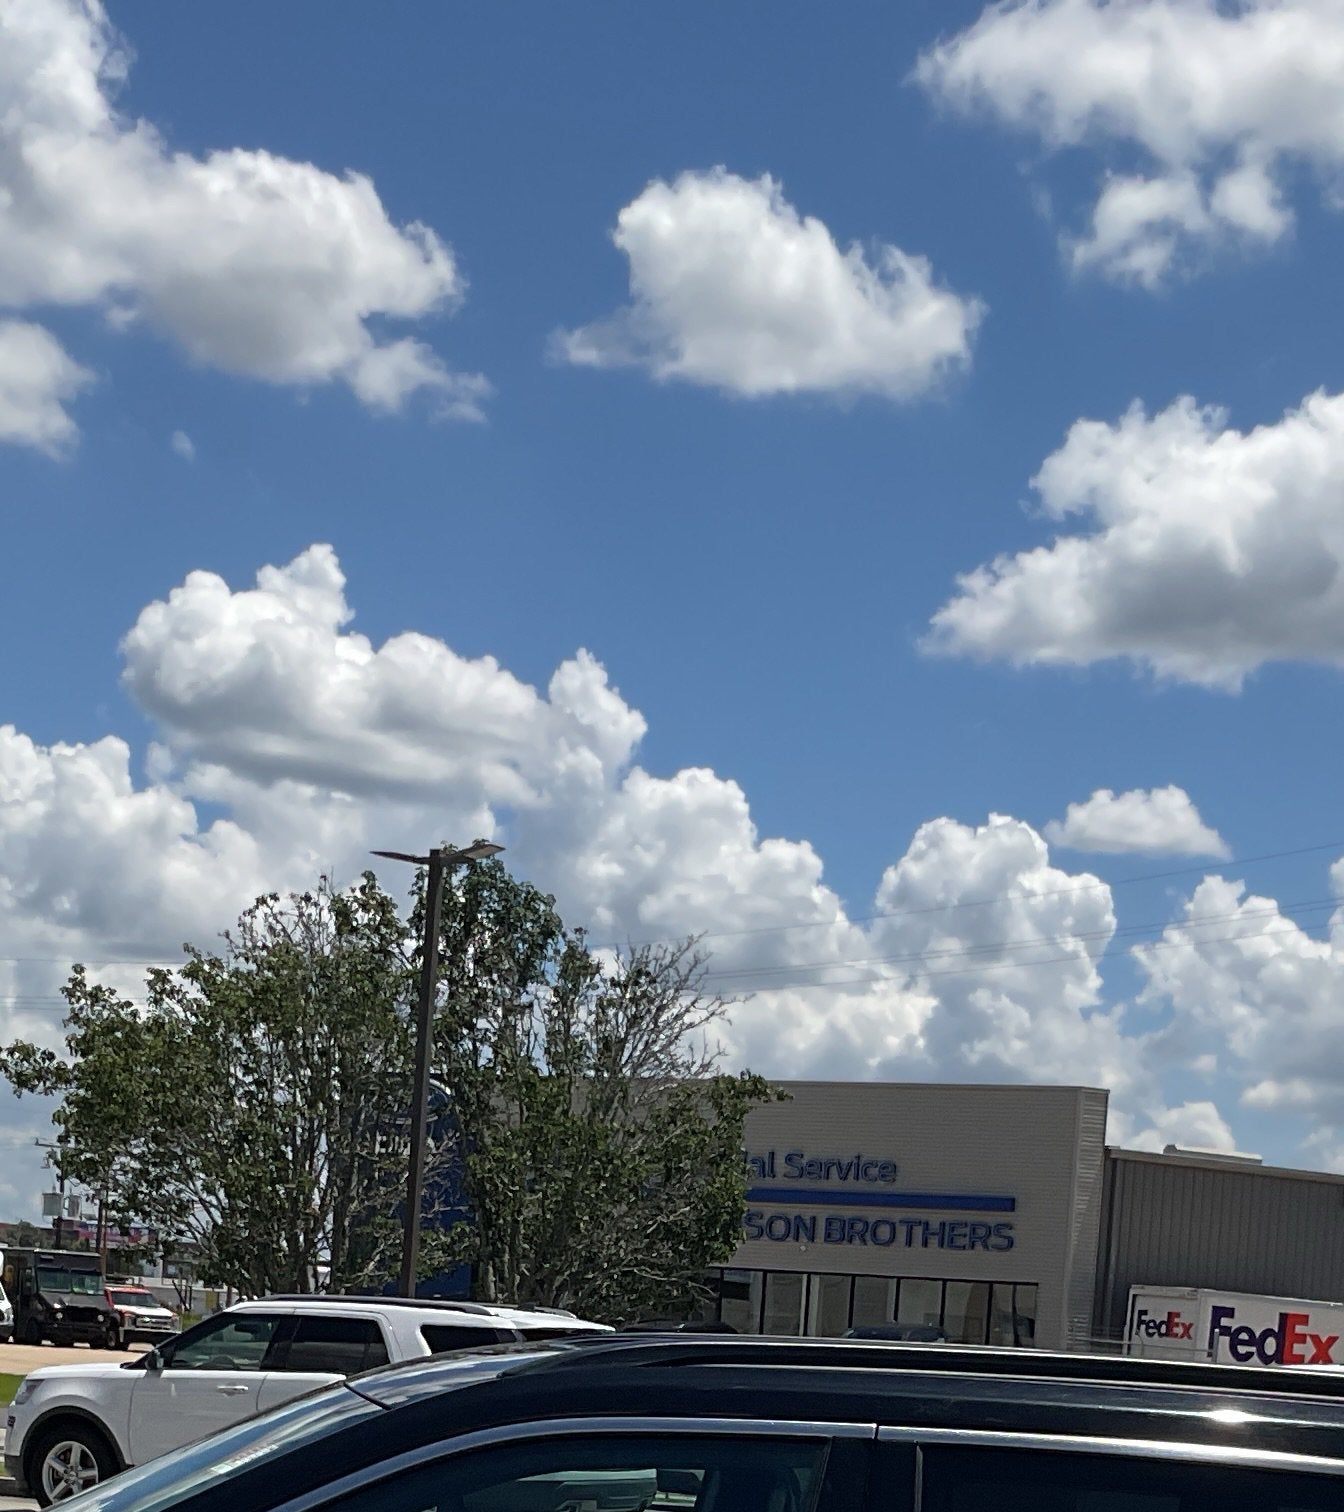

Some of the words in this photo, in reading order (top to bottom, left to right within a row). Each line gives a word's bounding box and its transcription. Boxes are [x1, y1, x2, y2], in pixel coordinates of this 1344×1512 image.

[784, 1152, 897, 1183] Service
[824, 1215, 1014, 1251] BROTHERS
[1136, 1309, 1193, 1341] FedEx
[1207, 1304, 1339, 1366] FedEx
